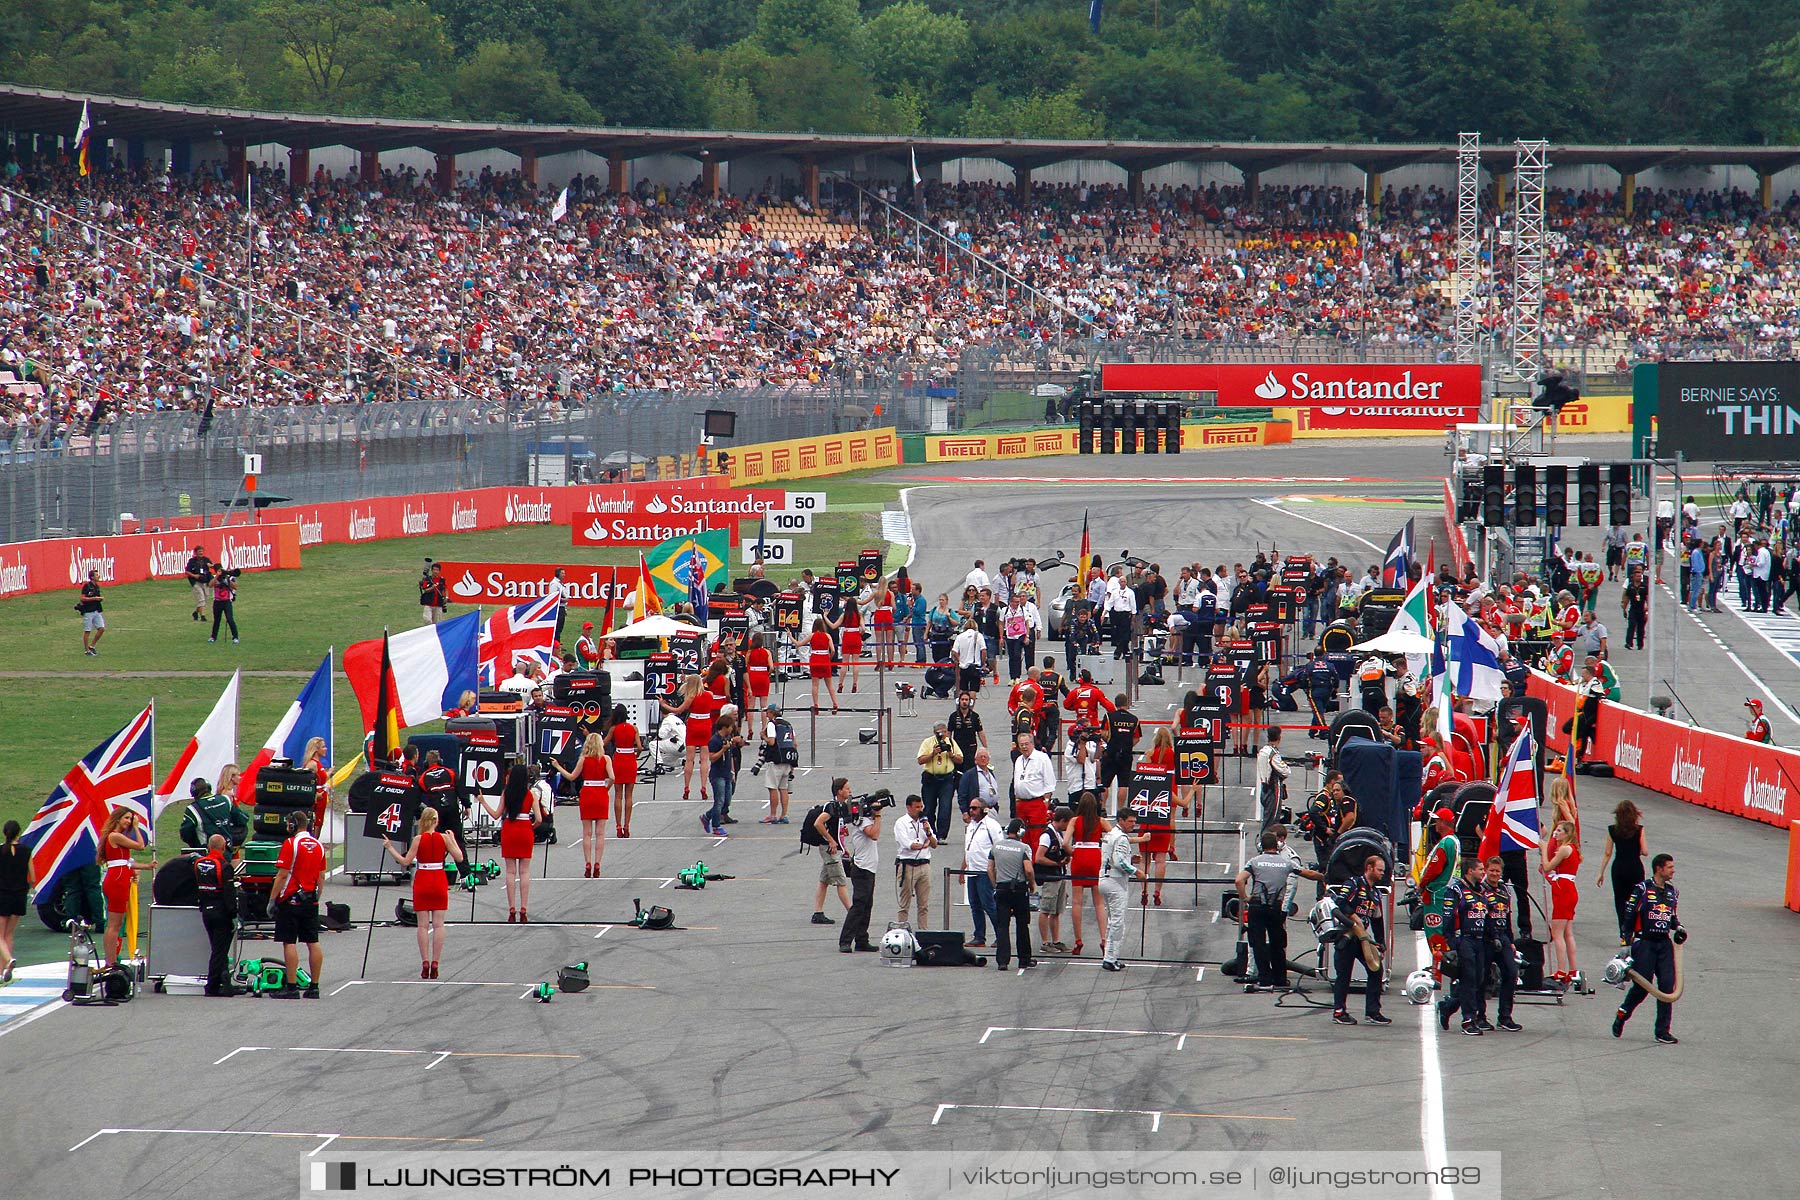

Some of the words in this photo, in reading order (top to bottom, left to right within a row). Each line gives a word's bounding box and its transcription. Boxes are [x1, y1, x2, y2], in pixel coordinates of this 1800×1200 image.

[1291, 371, 1443, 400] Santander
[1681, 388, 1735, 402] BERNIE
[1739, 388, 1780, 402] SAYS:
[875, 435, 892, 459] PIRELLI
[998, 437, 1026, 454] PIRELLI
[1034, 434, 1062, 451] PIRELLI
[1203, 426, 1258, 444] PIRELLI
[798, 445, 817, 470] PIRELLI
[824, 441, 843, 466] PIRELLI
[849, 438, 867, 463] PIRELLI
[939, 439, 986, 456] PIRELLI
[250, 457, 255, 472] 1
[745, 452, 763, 477] PIRELLI
[772, 449, 790, 473] PIRELLI
[514, 491, 552, 523] Santander
[596, 489, 634, 513] Santander
[671, 494, 775, 515] Santander
[796, 497, 815, 509] 50
[354, 505, 376, 540] Santander
[408, 500, 429, 534] Santander
[457, 498, 478, 530] Santander
[774, 515, 805, 528] 100
[299, 510, 323, 545] Santander
[229, 531, 272, 570] Santander
[839, 575, 857, 592] 19
[864, 563, 877, 580] 6
[778, 608, 800, 627] 14
[720, 626, 748, 646] 27
[672, 648, 699, 671] 22
[1256, 640, 1277, 661] 11
[1233, 659, 1251, 682] 7
[645, 673, 676, 695] 25
[1214, 685, 1232, 707] 8
[568, 700, 601, 724] 99
[1193, 717, 1222, 742] 21
[540, 729, 573, 755] 17
[1620, 729, 1643, 774] Santander
[465, 759, 498, 789] 10
[1179, 751, 1210, 779] 13
[1677, 746, 1705, 793] Santander
[386, 777, 410, 785] Santander
[1752, 766, 1787, 816] Santander
[1129, 788, 1171, 819] 44
[377, 802, 402, 833] 4
